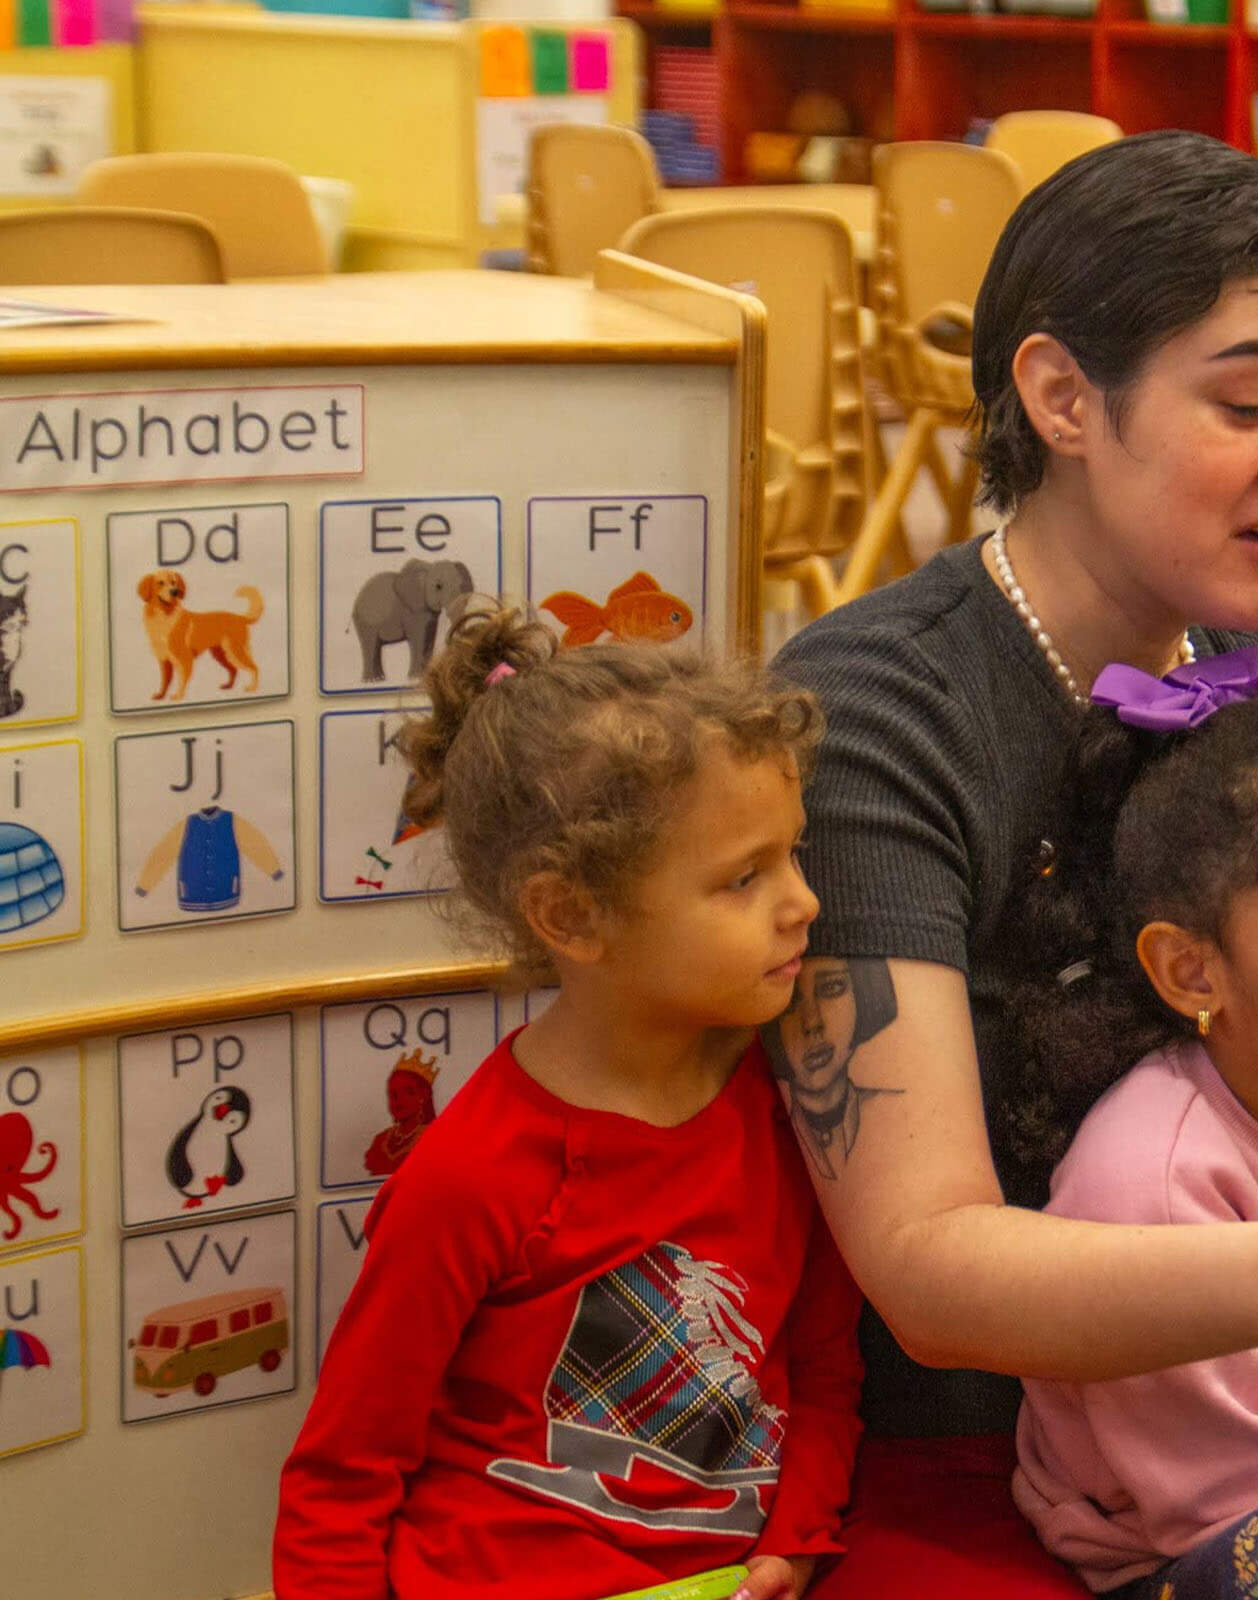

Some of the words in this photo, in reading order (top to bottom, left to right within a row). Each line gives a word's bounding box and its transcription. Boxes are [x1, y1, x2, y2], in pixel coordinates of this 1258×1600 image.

[17, 399, 350, 474] Alphabet
[157, 511, 238, 567] Dd
[371, 505, 451, 553] Ee
[589, 503, 653, 551] Ff
[169, 737, 225, 800] Jj
[363, 1003, 451, 1055] Qq
[171, 1032, 244, 1082] Pp
[164, 1234, 249, 1283] Vv
